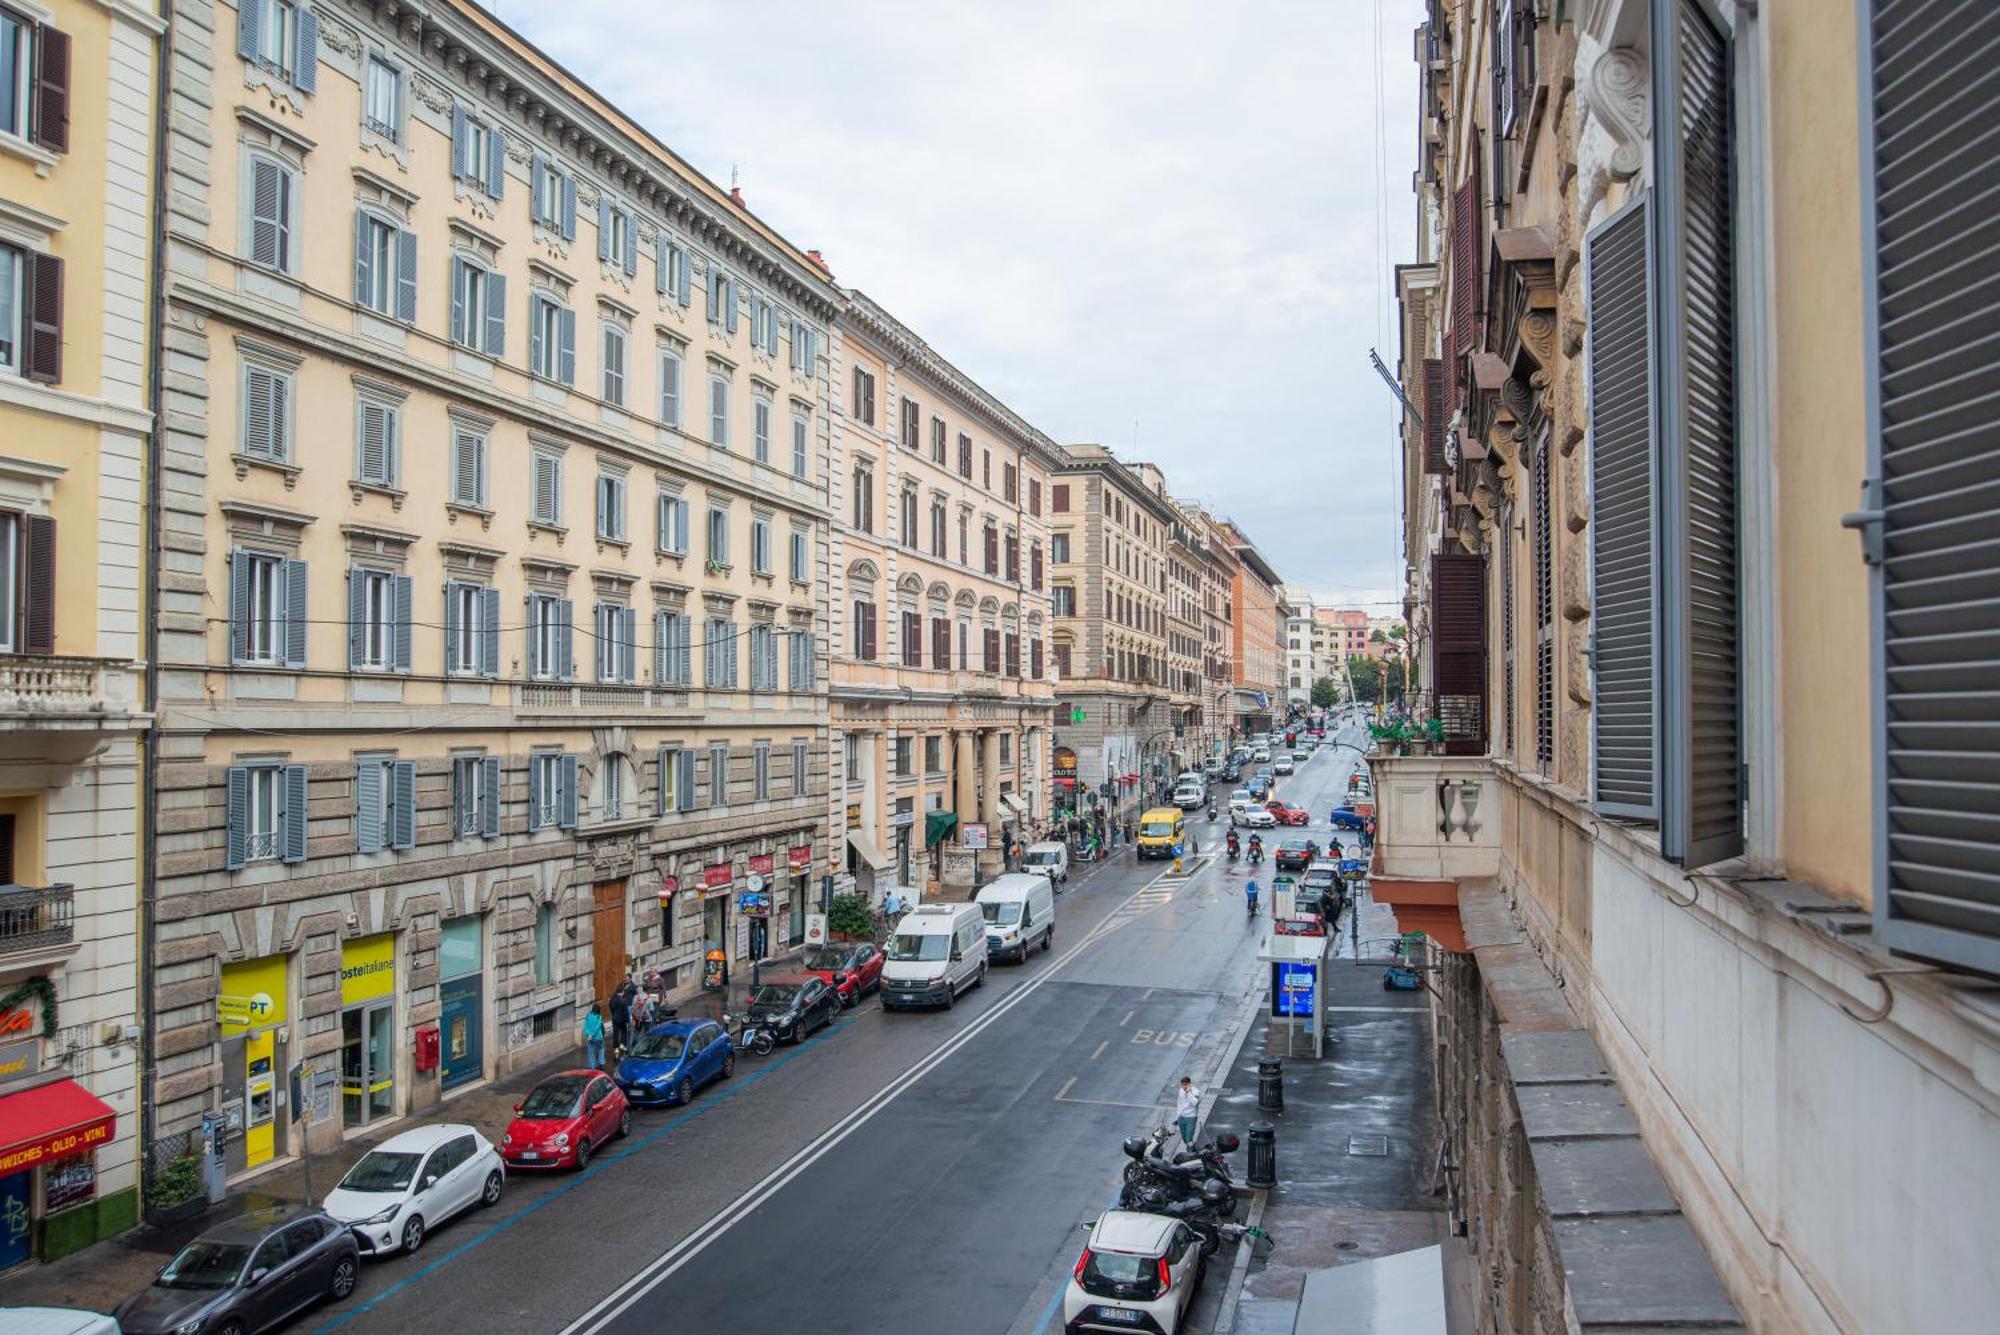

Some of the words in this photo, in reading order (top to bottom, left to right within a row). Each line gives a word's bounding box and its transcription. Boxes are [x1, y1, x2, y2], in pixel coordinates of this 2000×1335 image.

[341, 960, 394, 981] osteitaliane
[250, 1001, 268, 1015] PT
[1130, 1029, 1197, 1046] BUS
[52, 1135, 77, 1153] OLIO
[84, 1125, 107, 1142] VINI
